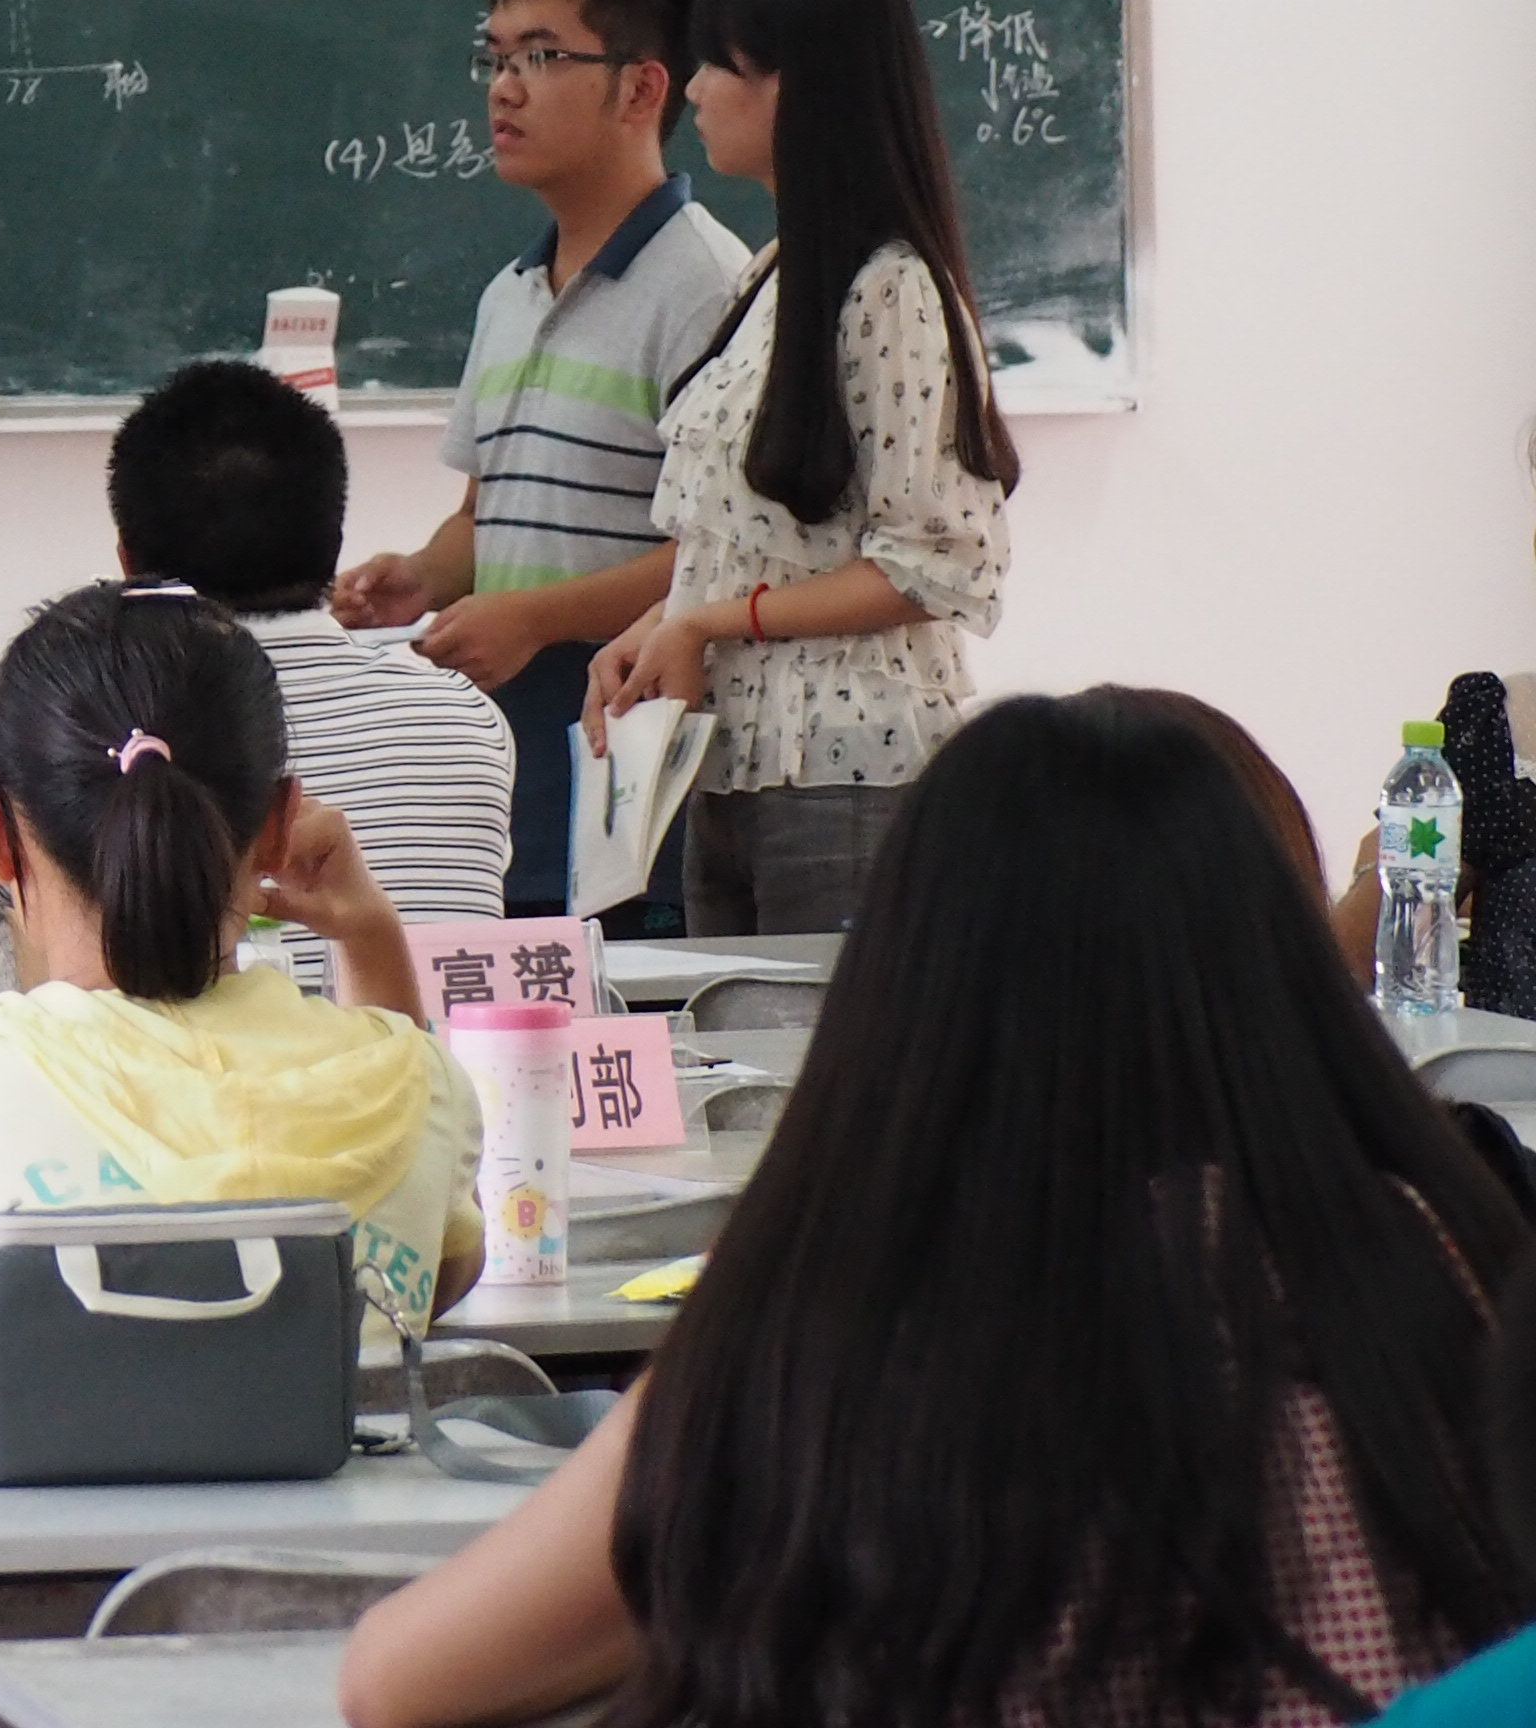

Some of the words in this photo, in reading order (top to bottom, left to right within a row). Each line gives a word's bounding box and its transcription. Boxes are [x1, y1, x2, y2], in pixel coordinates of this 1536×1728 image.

[570, 1043, 643, 1130] 部
[517, 1200, 539, 1229] B
[348, 1220, 434, 1314] TES
